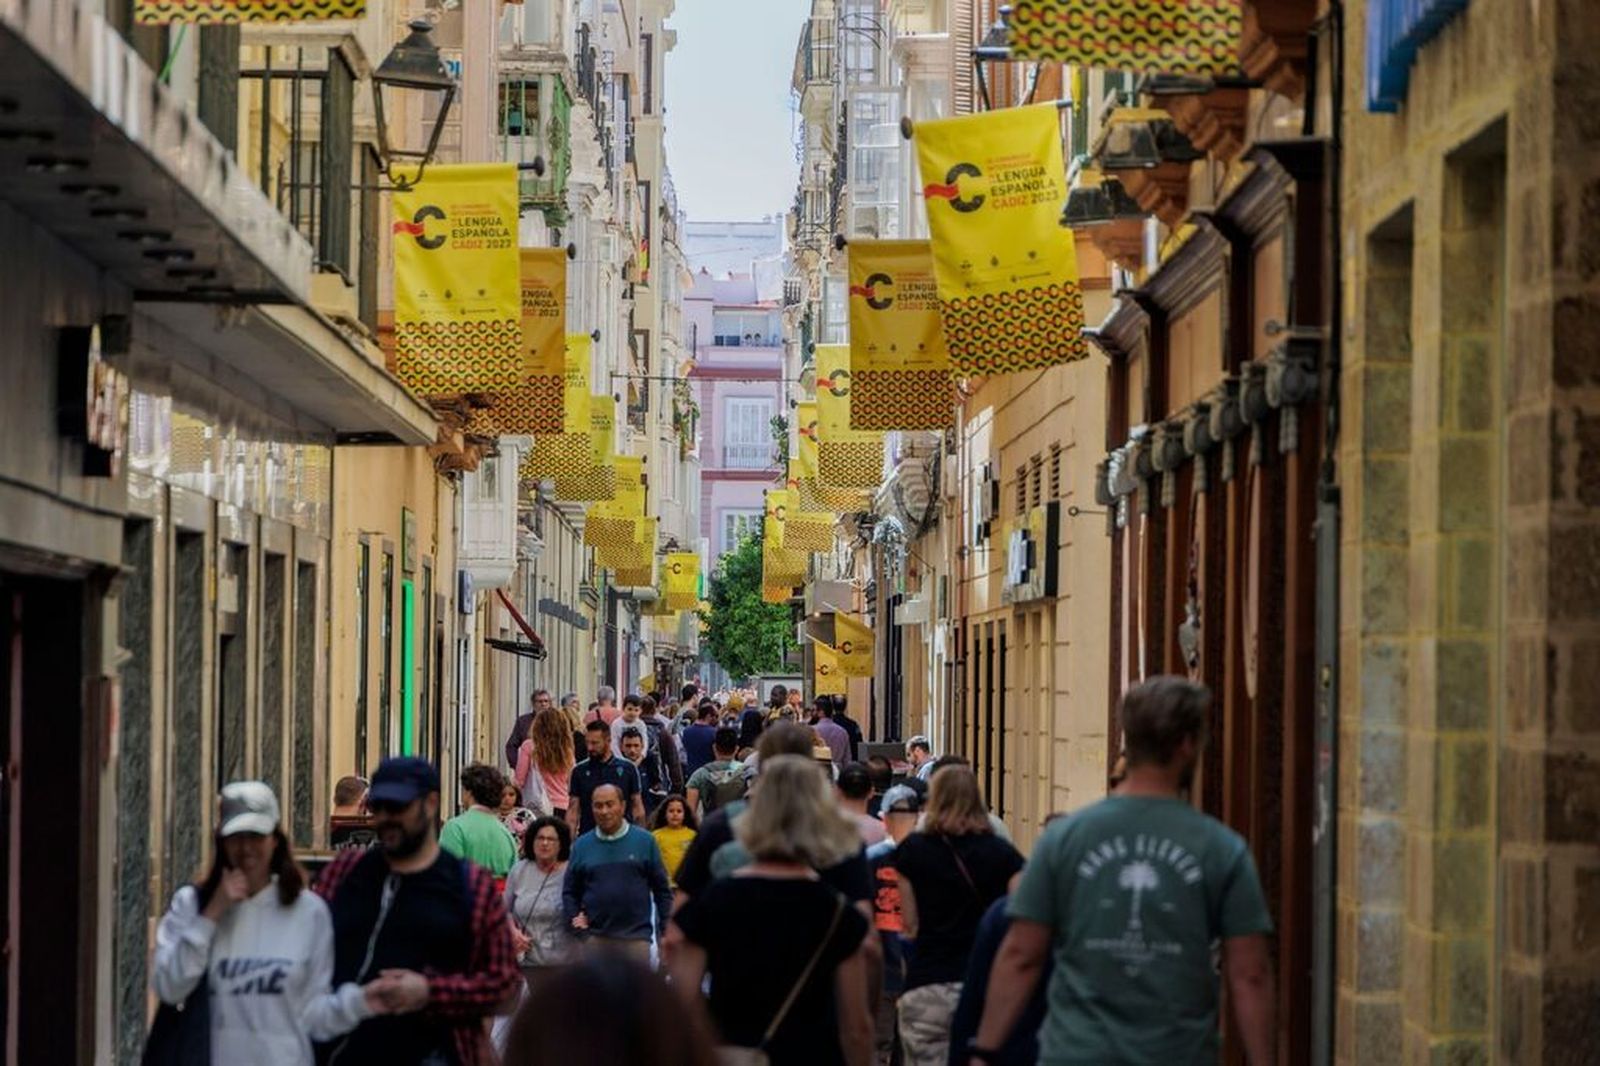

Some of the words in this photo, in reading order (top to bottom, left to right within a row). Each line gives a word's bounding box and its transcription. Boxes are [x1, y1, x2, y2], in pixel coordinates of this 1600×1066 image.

[996, 166, 1046, 182] LENGUA
[458, 216, 502, 227] LENGUA
[522, 290, 553, 298] ENGUA
